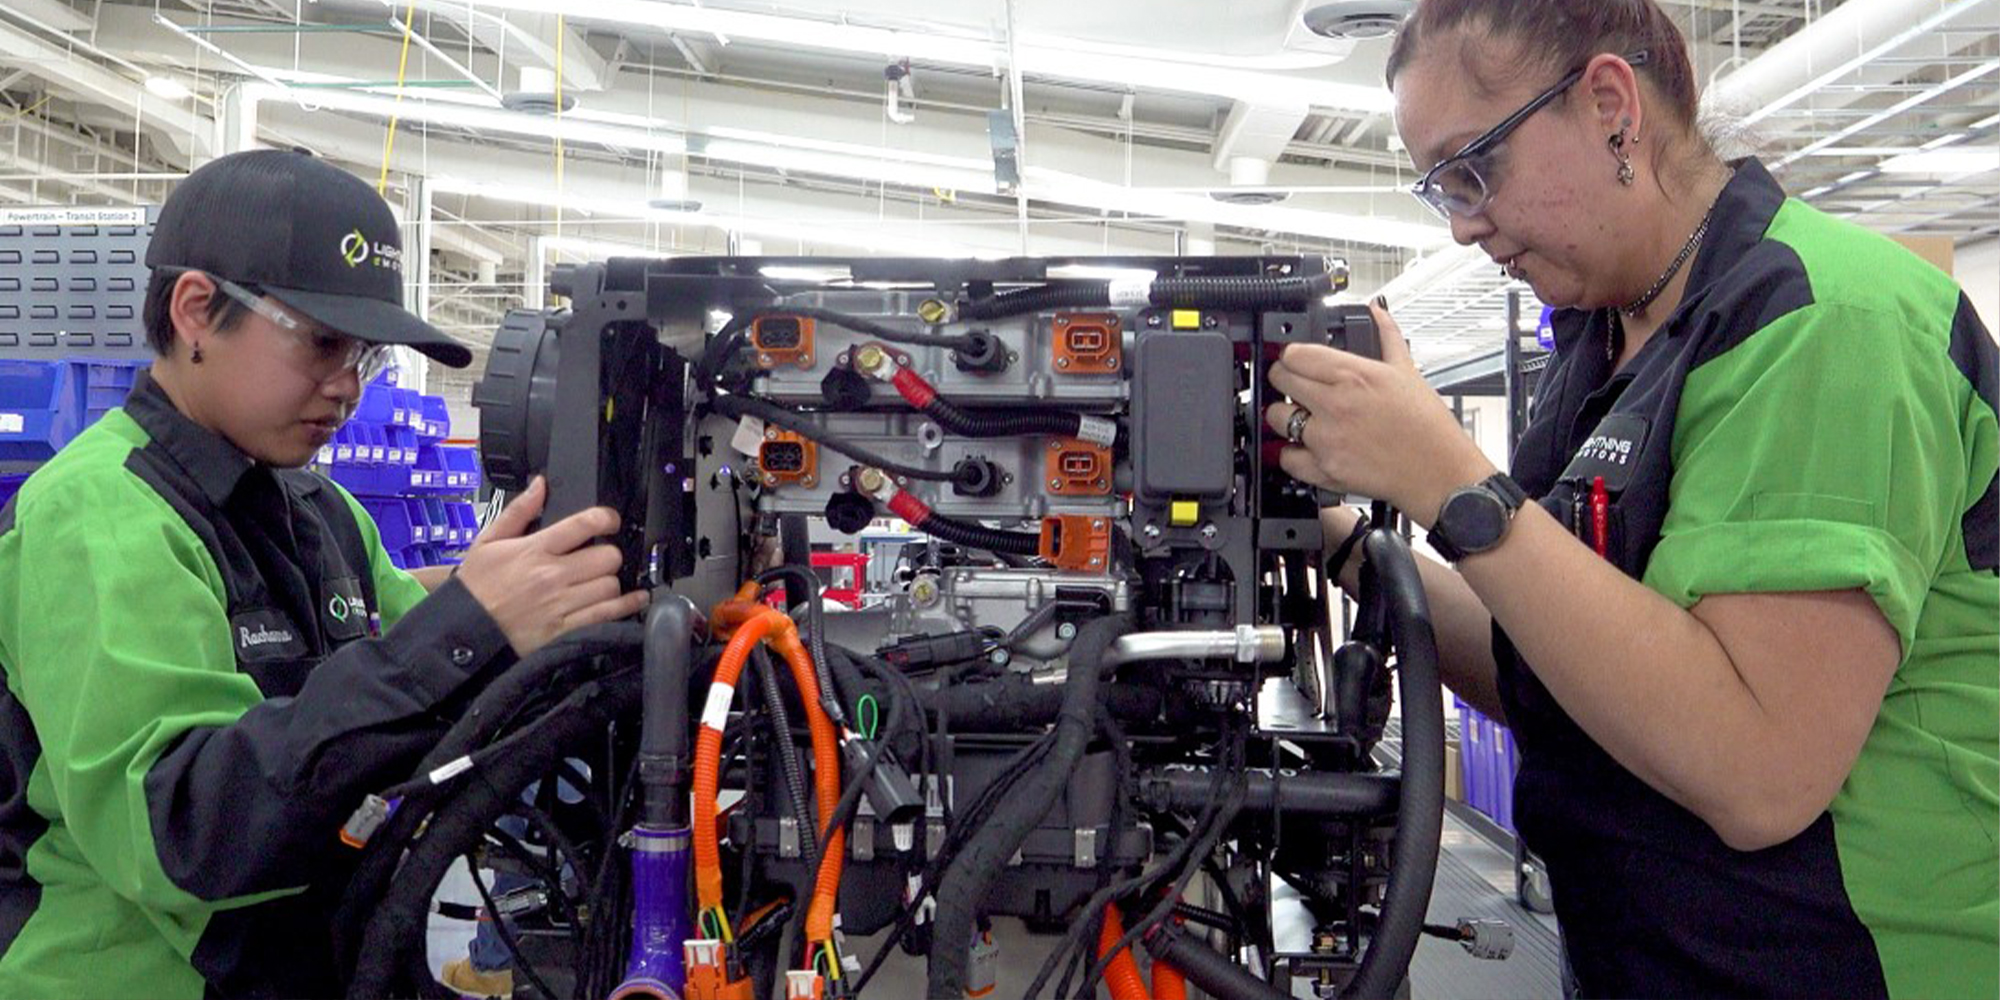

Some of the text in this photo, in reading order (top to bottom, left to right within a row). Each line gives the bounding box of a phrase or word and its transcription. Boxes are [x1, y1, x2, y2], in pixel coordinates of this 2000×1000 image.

[7, 211, 56, 221] Powertrain
[66, 211, 96, 221] Transit
[97, 211, 129, 221] Station
[131, 211, 137, 221] 2
